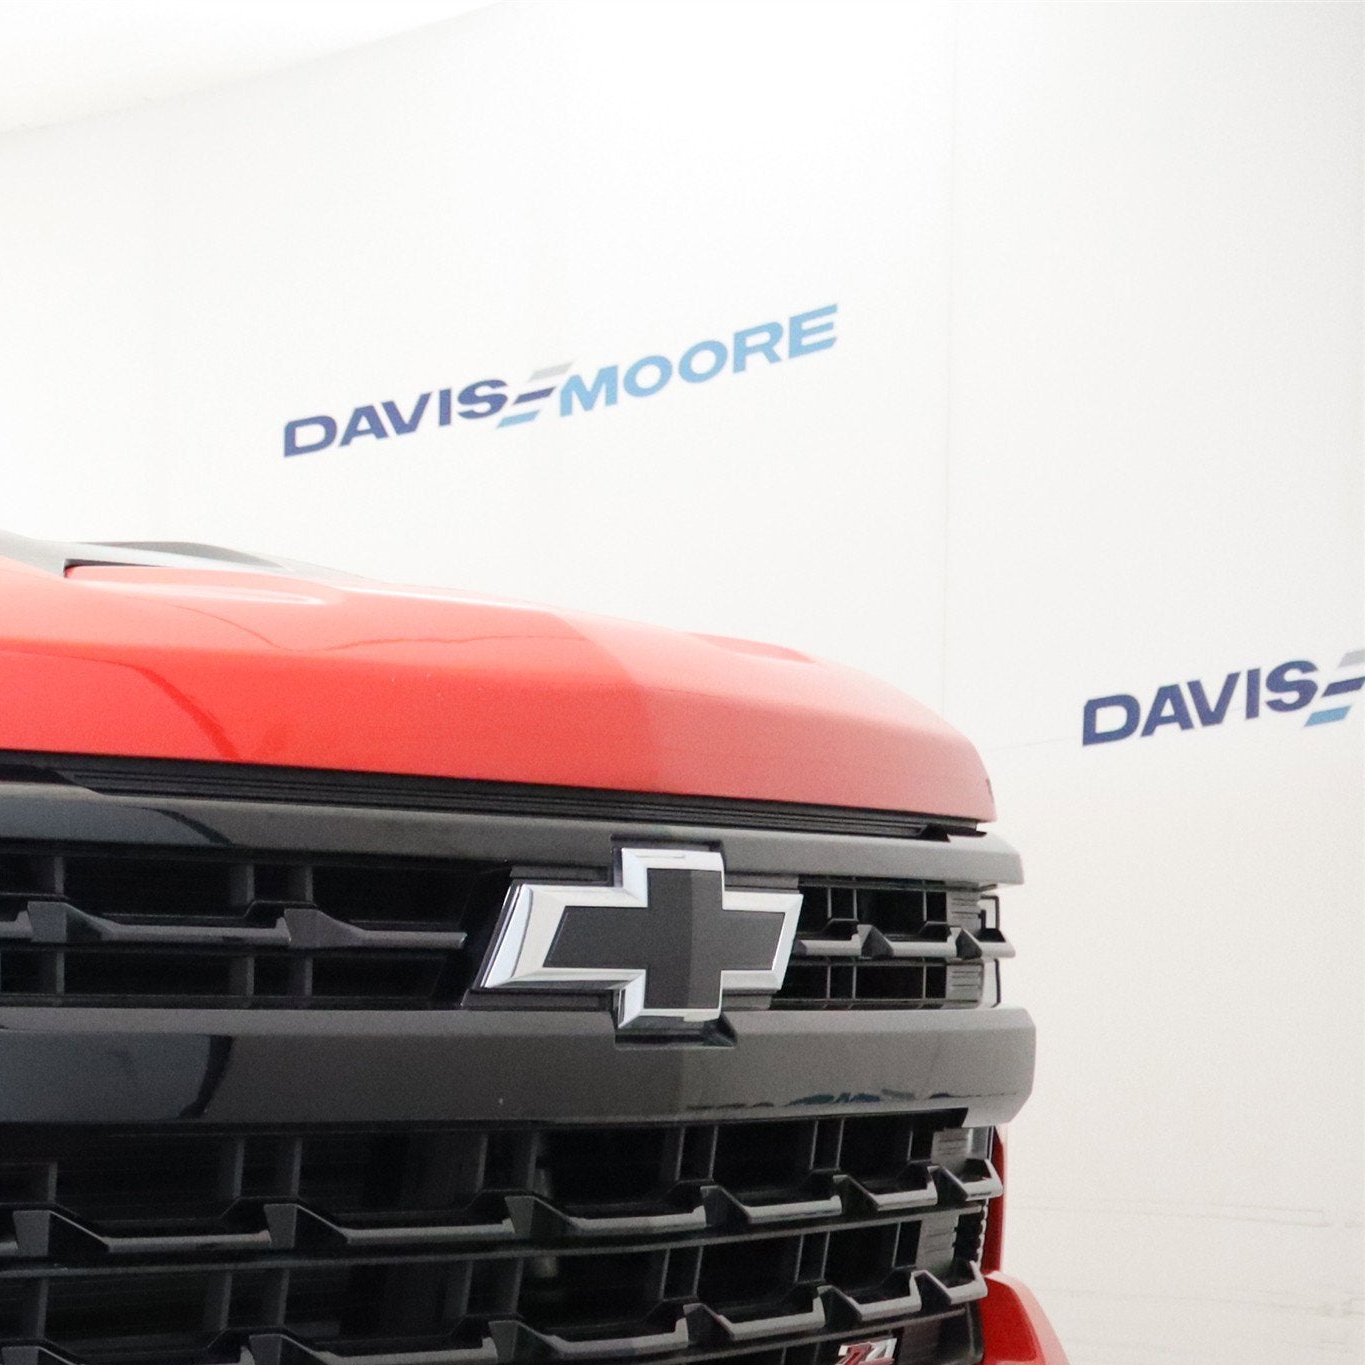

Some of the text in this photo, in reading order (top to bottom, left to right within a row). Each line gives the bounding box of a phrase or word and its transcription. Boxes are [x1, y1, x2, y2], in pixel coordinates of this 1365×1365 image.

[282, 302, 839, 458] DAVIS MOORE
[1081, 658, 1320, 748] DAVIS
